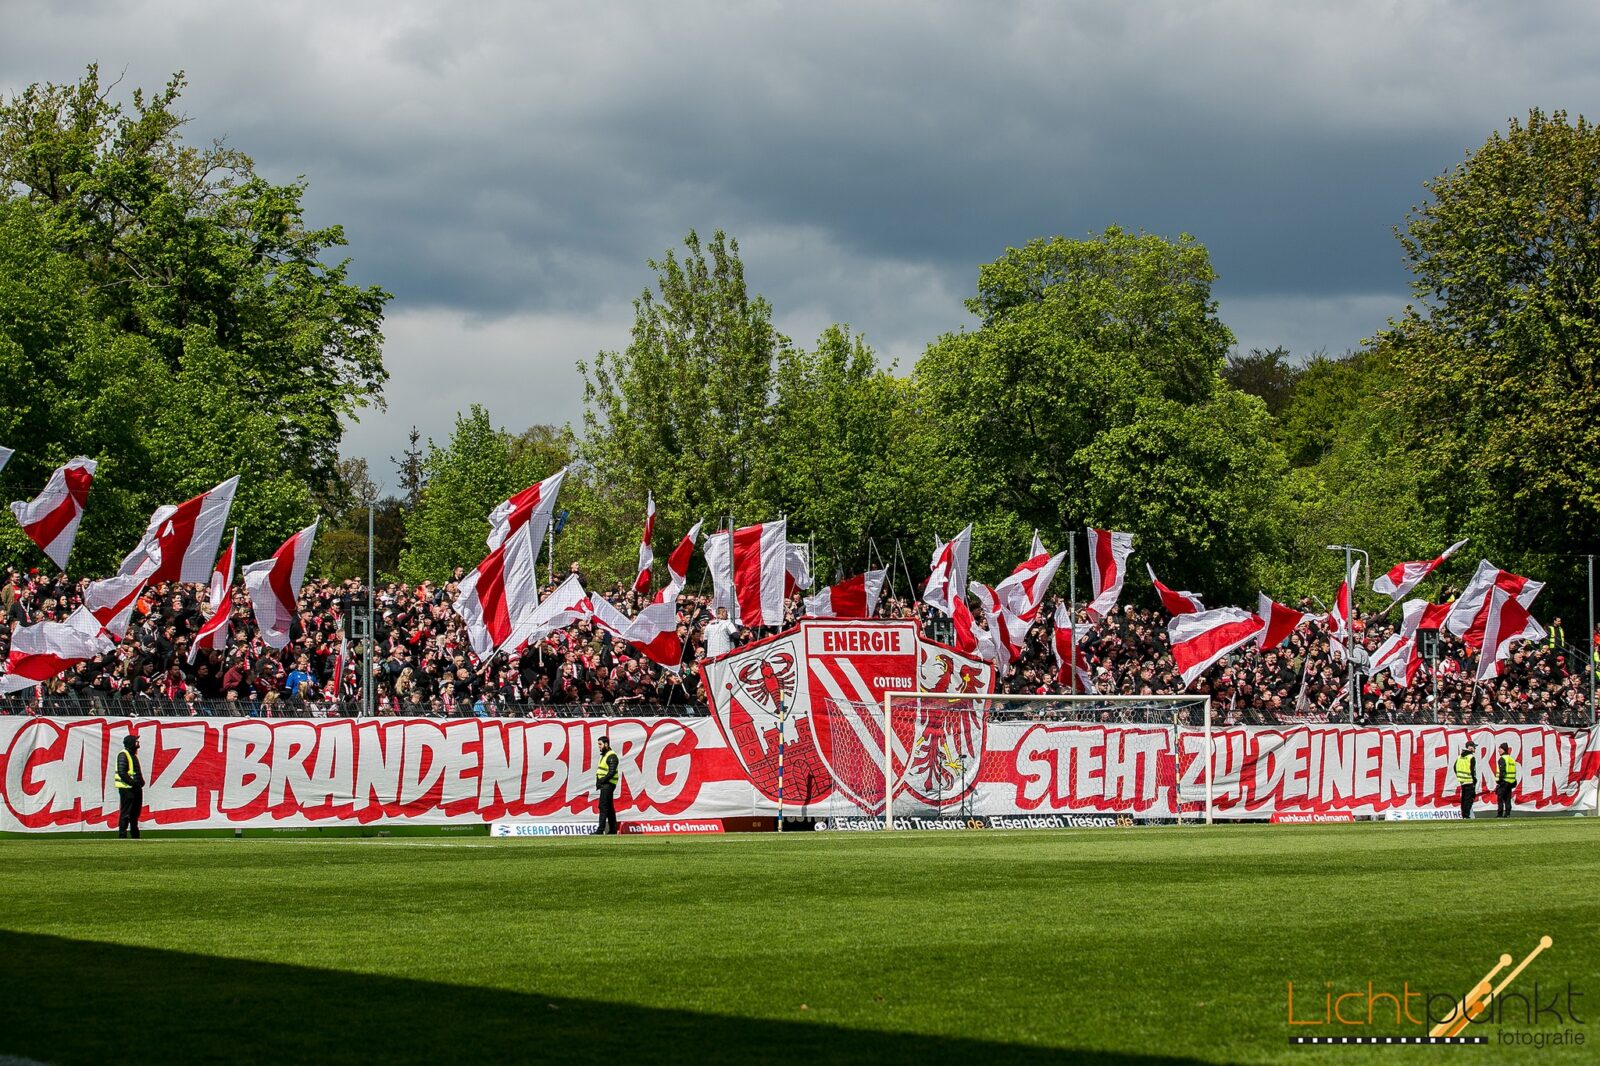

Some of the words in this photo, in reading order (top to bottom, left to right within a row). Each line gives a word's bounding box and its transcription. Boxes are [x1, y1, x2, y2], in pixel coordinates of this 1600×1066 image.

[823, 631, 901, 652] ENERGIE
[873, 676, 912, 689] COTTBUS
[4, 718, 211, 824] GANZ
[219, 719, 697, 819] BRANDENBURG
[1015, 725, 1167, 810] STEHT
[1250, 730, 1411, 810] DEINEN
[834, 817, 911, 831] Eisenbch
[990, 815, 1064, 828] Eisenbach
[1279, 814, 1312, 823] nahkauf
[1313, 813, 1349, 823] Oelmann
[629, 822, 670, 833] nahkauf
[673, 822, 718, 831] Oelmann
